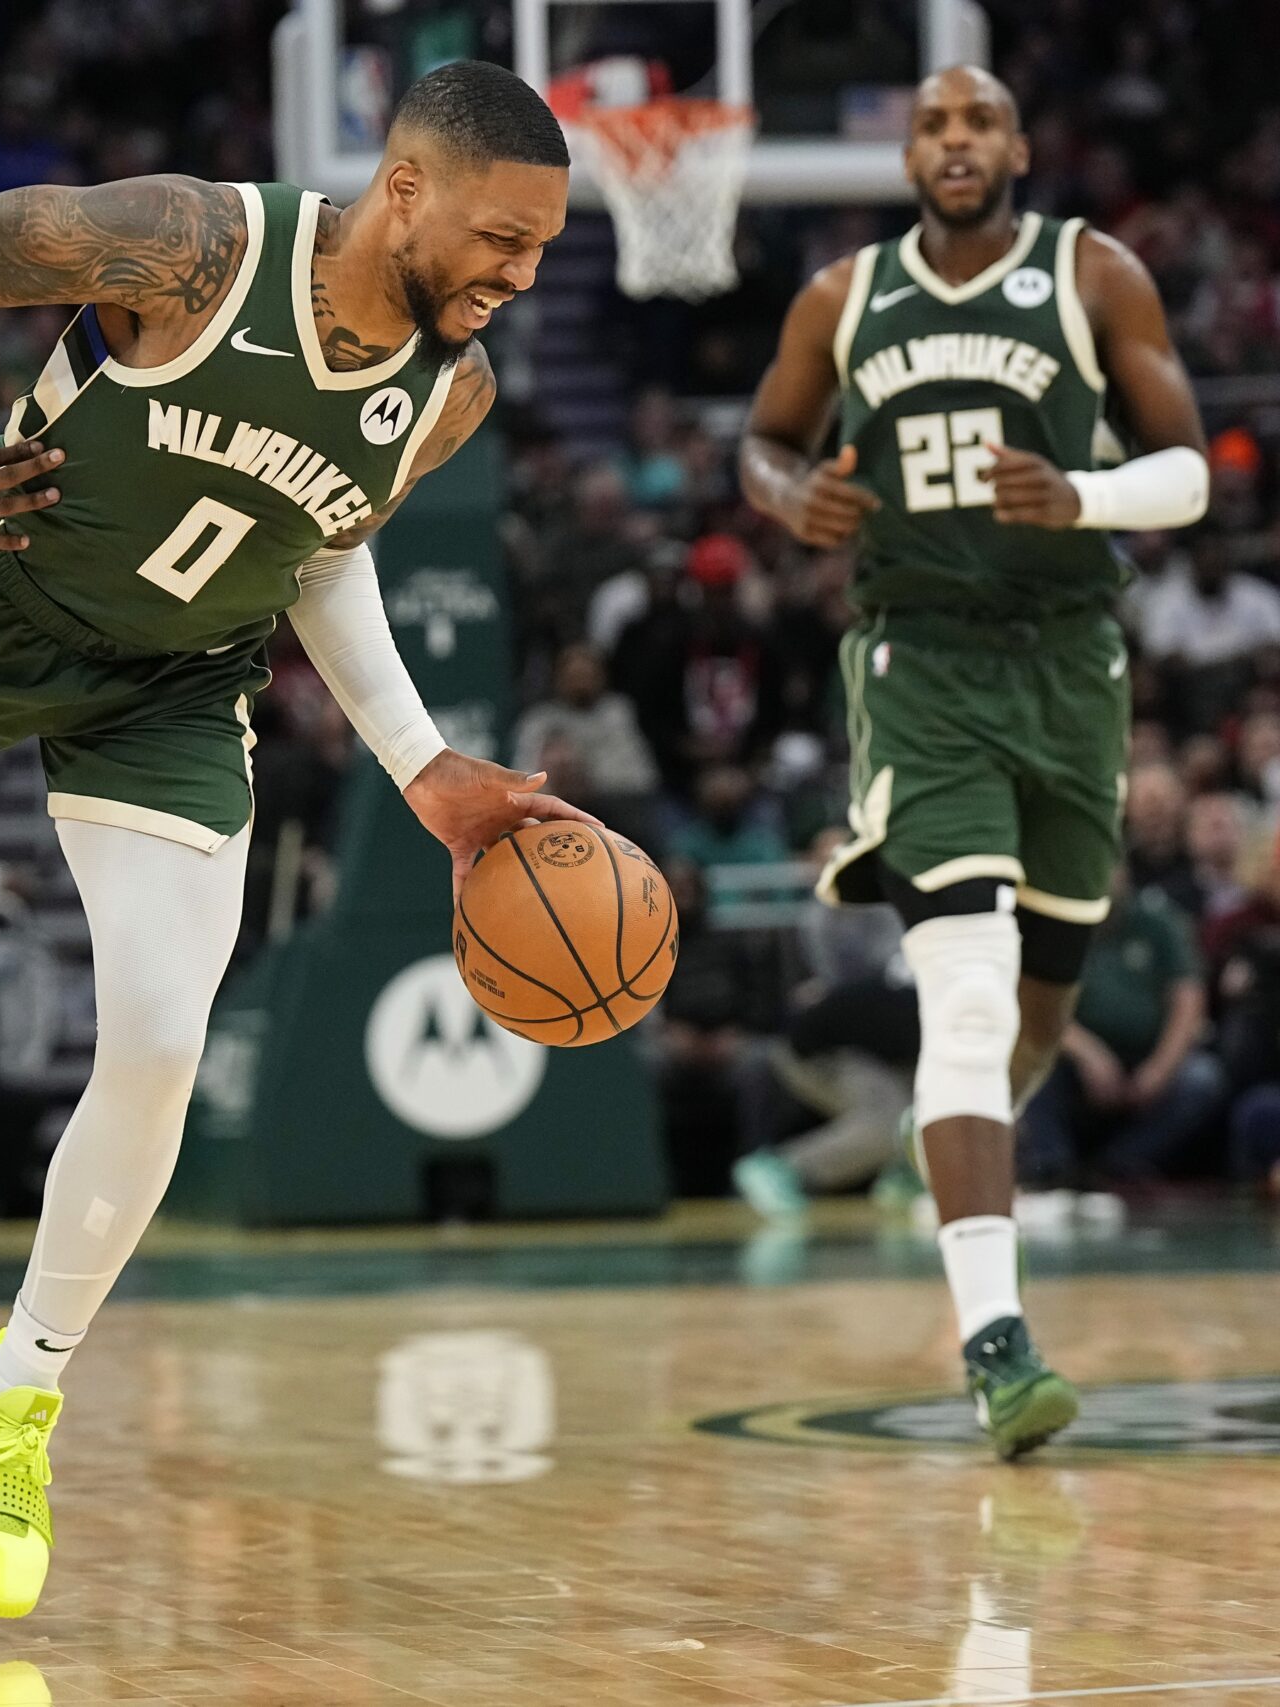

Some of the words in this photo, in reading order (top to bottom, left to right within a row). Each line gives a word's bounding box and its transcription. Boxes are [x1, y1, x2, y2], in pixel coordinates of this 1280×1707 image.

[853, 333, 1061, 410] MILWAUKEE
[895, 406, 1005, 513] 22
[136, 496, 257, 604] 0
